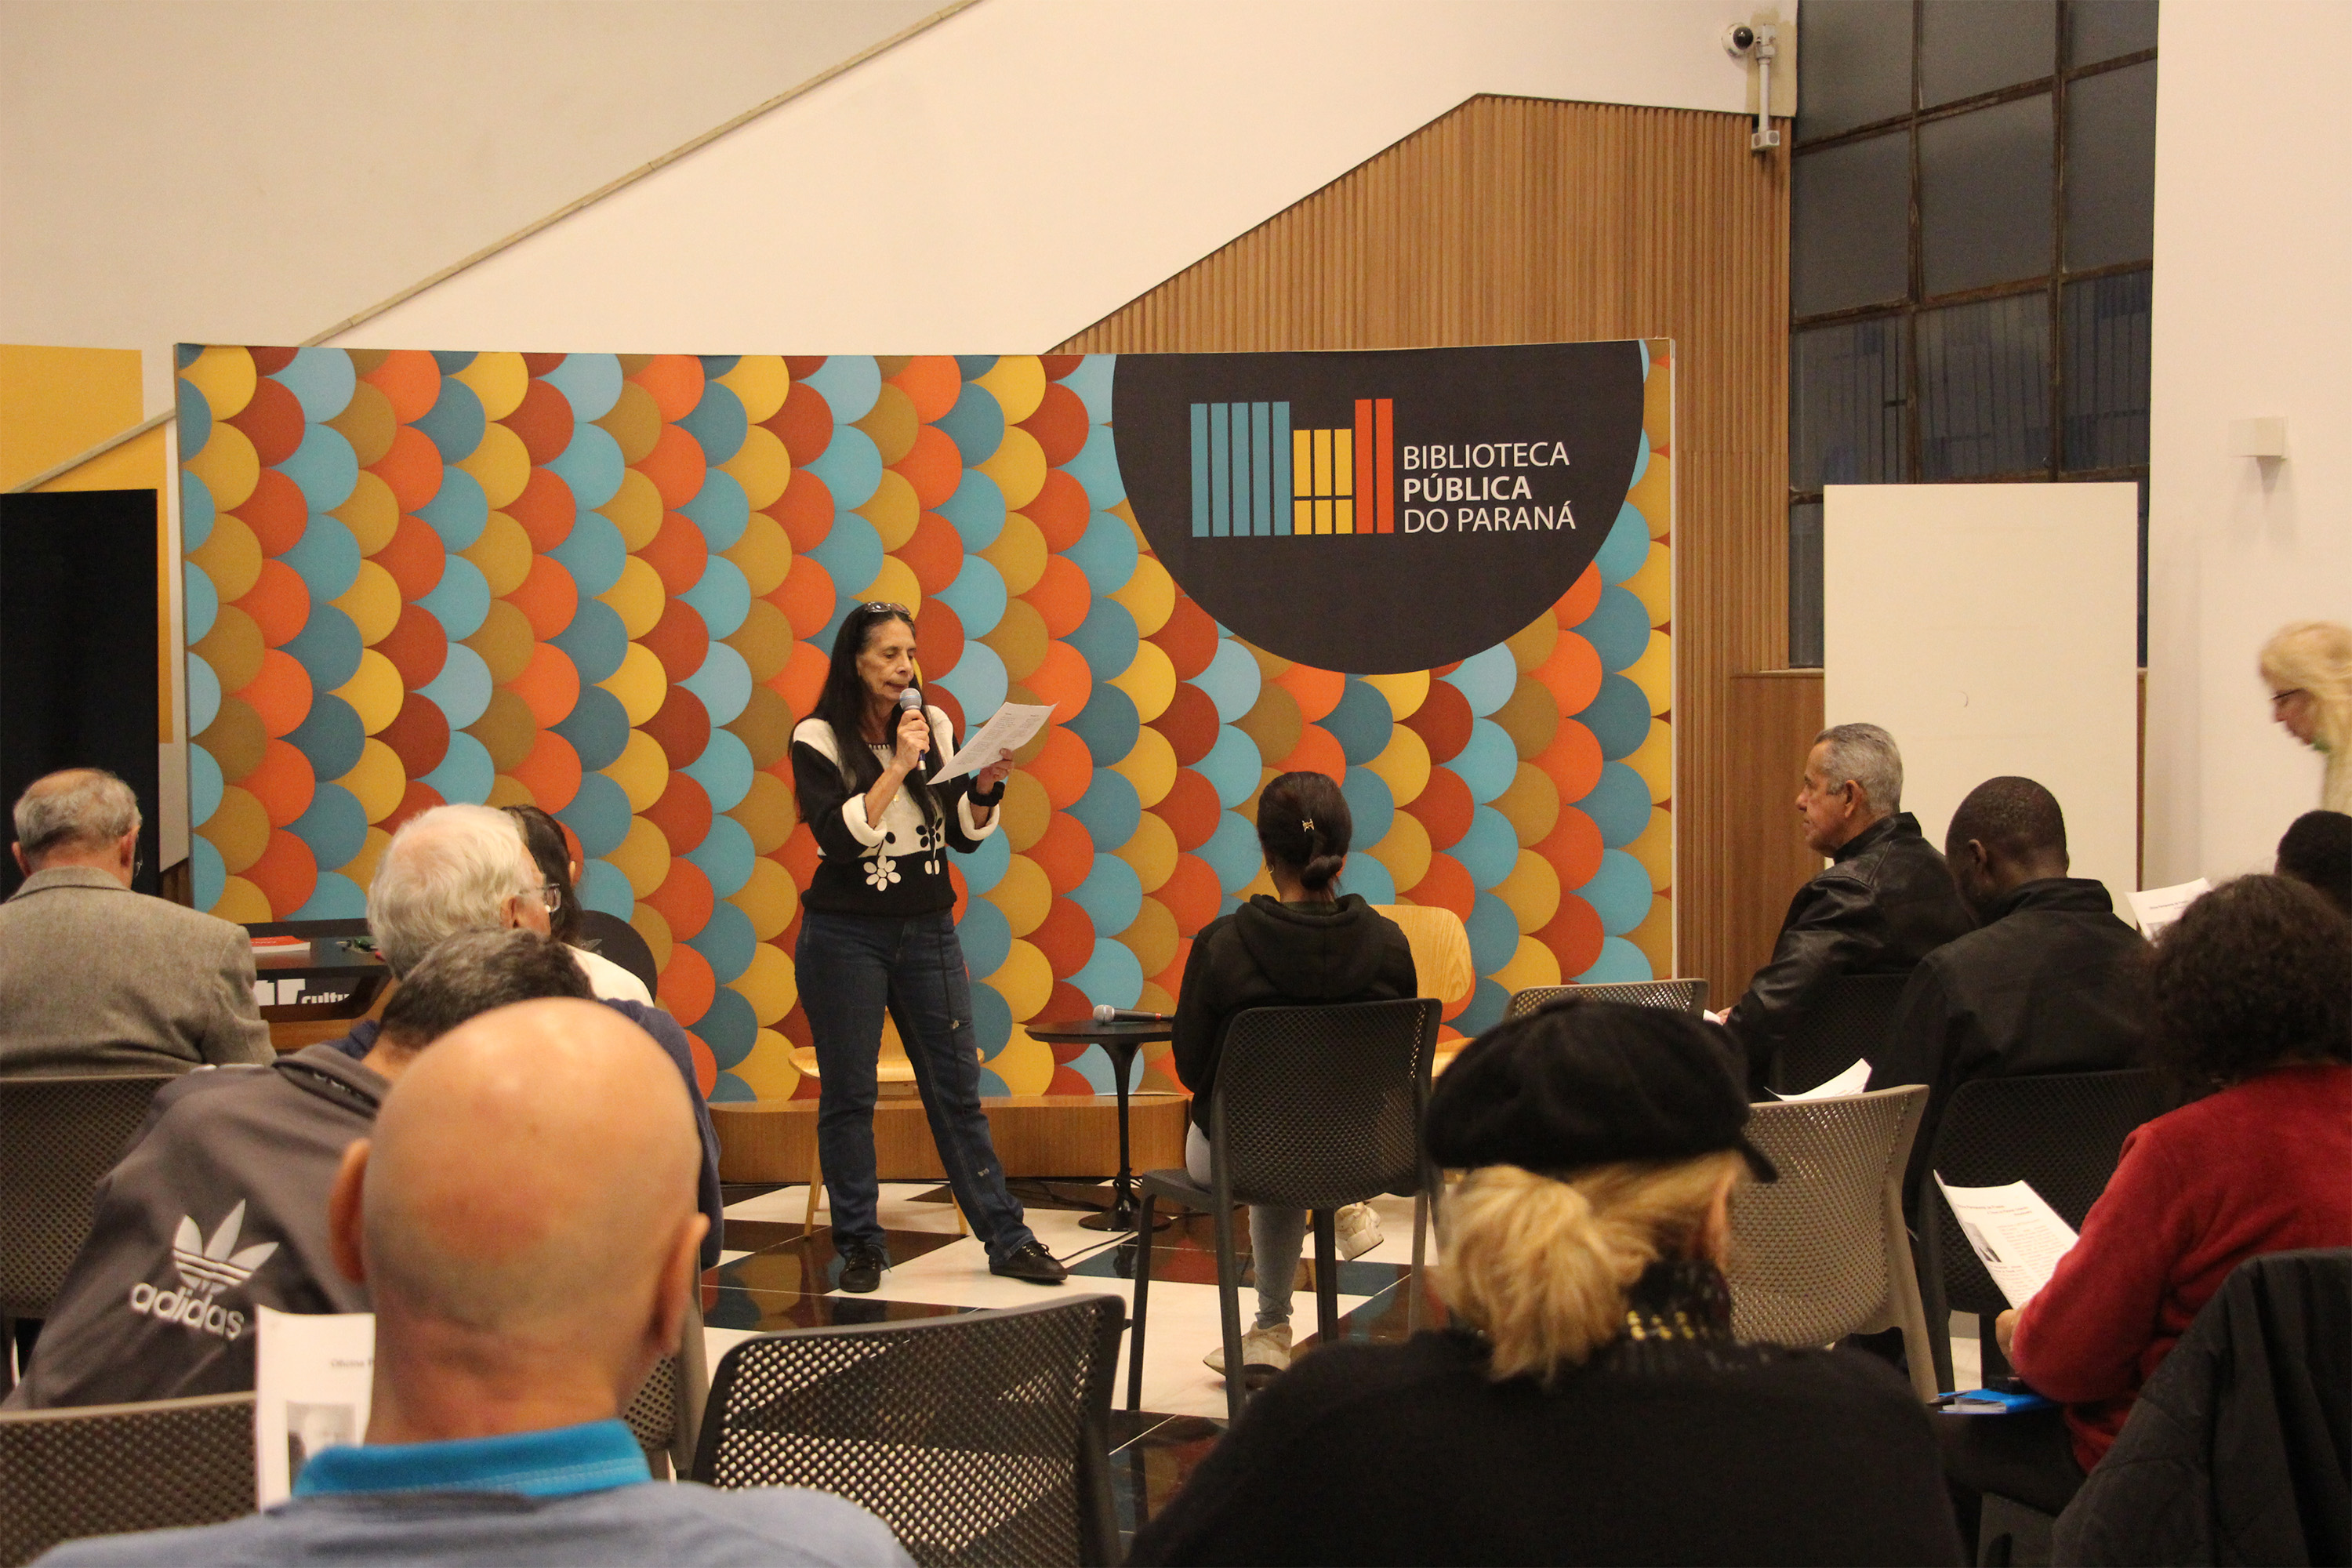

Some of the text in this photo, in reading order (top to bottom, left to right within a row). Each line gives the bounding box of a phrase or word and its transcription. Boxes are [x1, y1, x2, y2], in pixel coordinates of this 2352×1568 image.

[1403, 441, 1570, 470] BIBLIOTECA
[1403, 473, 1533, 503] PÚBLICA
[1404, 500, 1577, 534] DO PARANÁ
[129, 1282, 245, 1341] adidas
